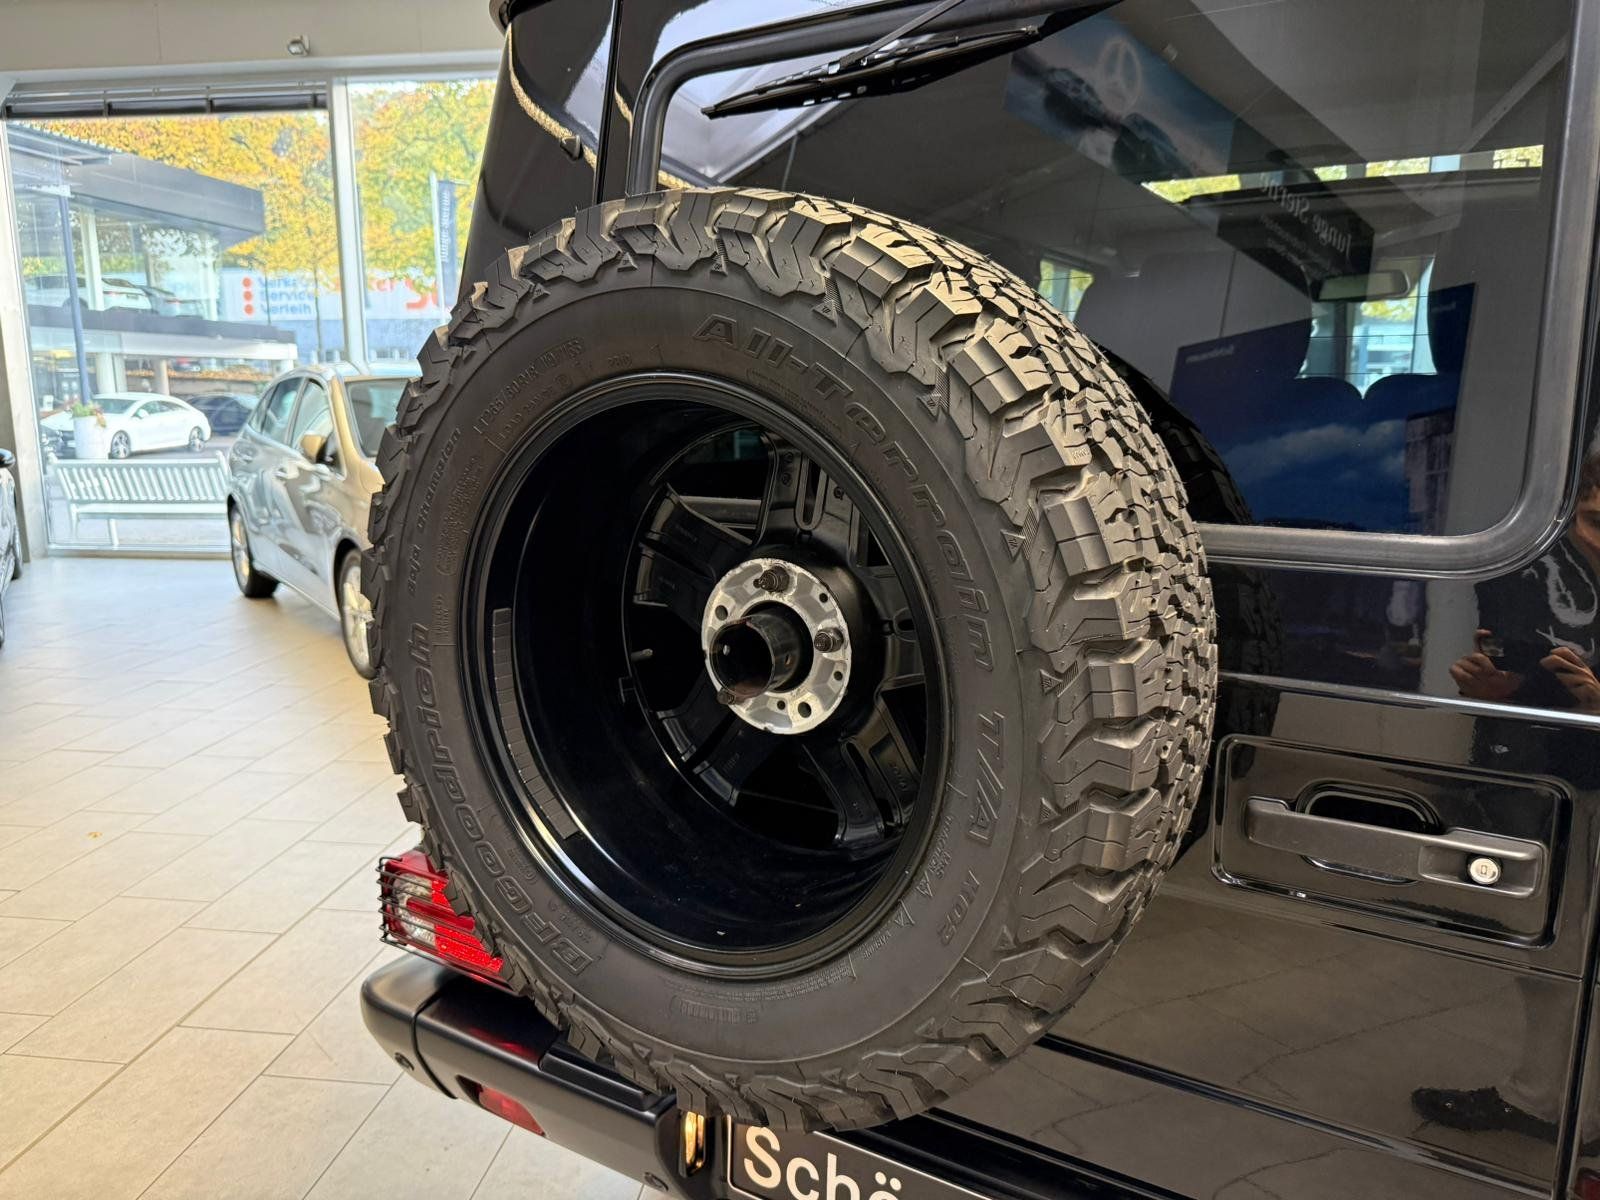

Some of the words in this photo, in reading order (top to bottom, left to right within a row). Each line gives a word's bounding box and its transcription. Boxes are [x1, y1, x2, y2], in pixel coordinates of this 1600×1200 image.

[693, 312, 995, 673] All-Terrain
[408, 621, 594, 975] BFGoodrich
[968, 710, 1005, 847] T/A
